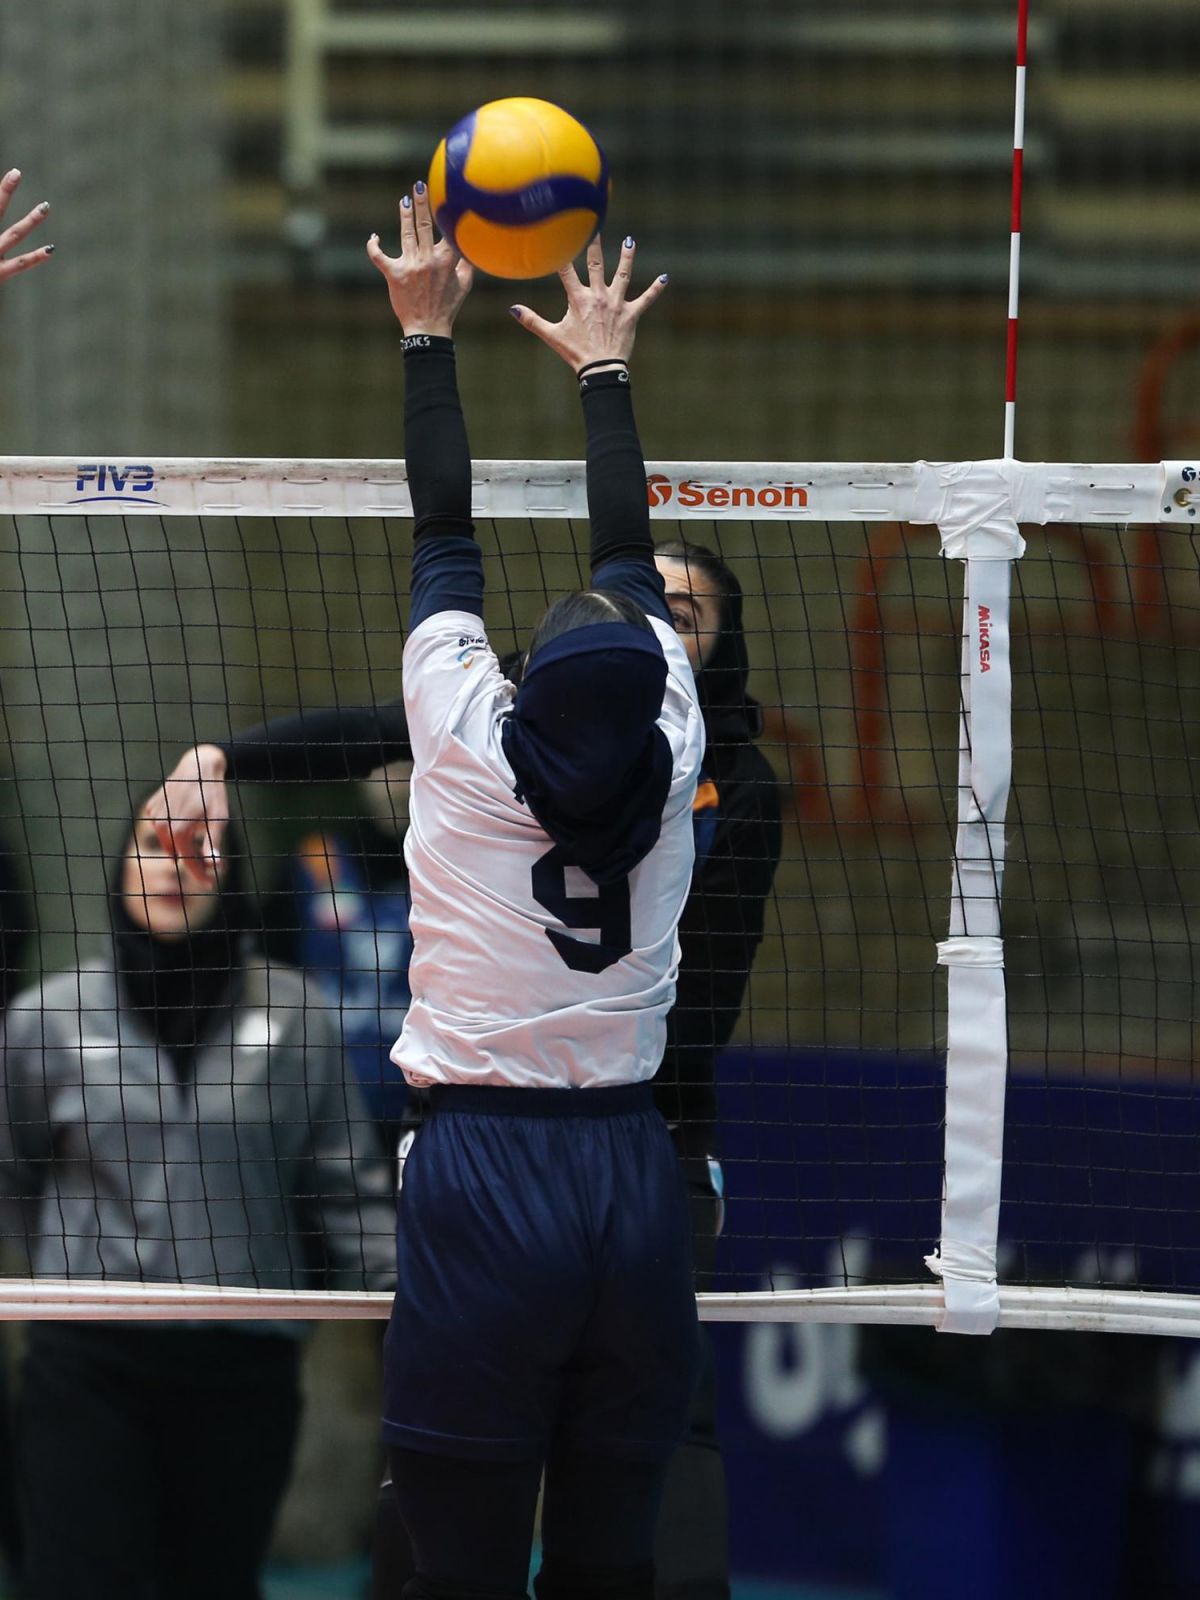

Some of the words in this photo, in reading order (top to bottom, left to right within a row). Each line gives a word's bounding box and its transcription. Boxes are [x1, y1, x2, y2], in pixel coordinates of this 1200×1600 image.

[76, 464, 155, 492] FIVB
[677, 481, 808, 508] Senoh
[531, 840, 634, 975] 9
